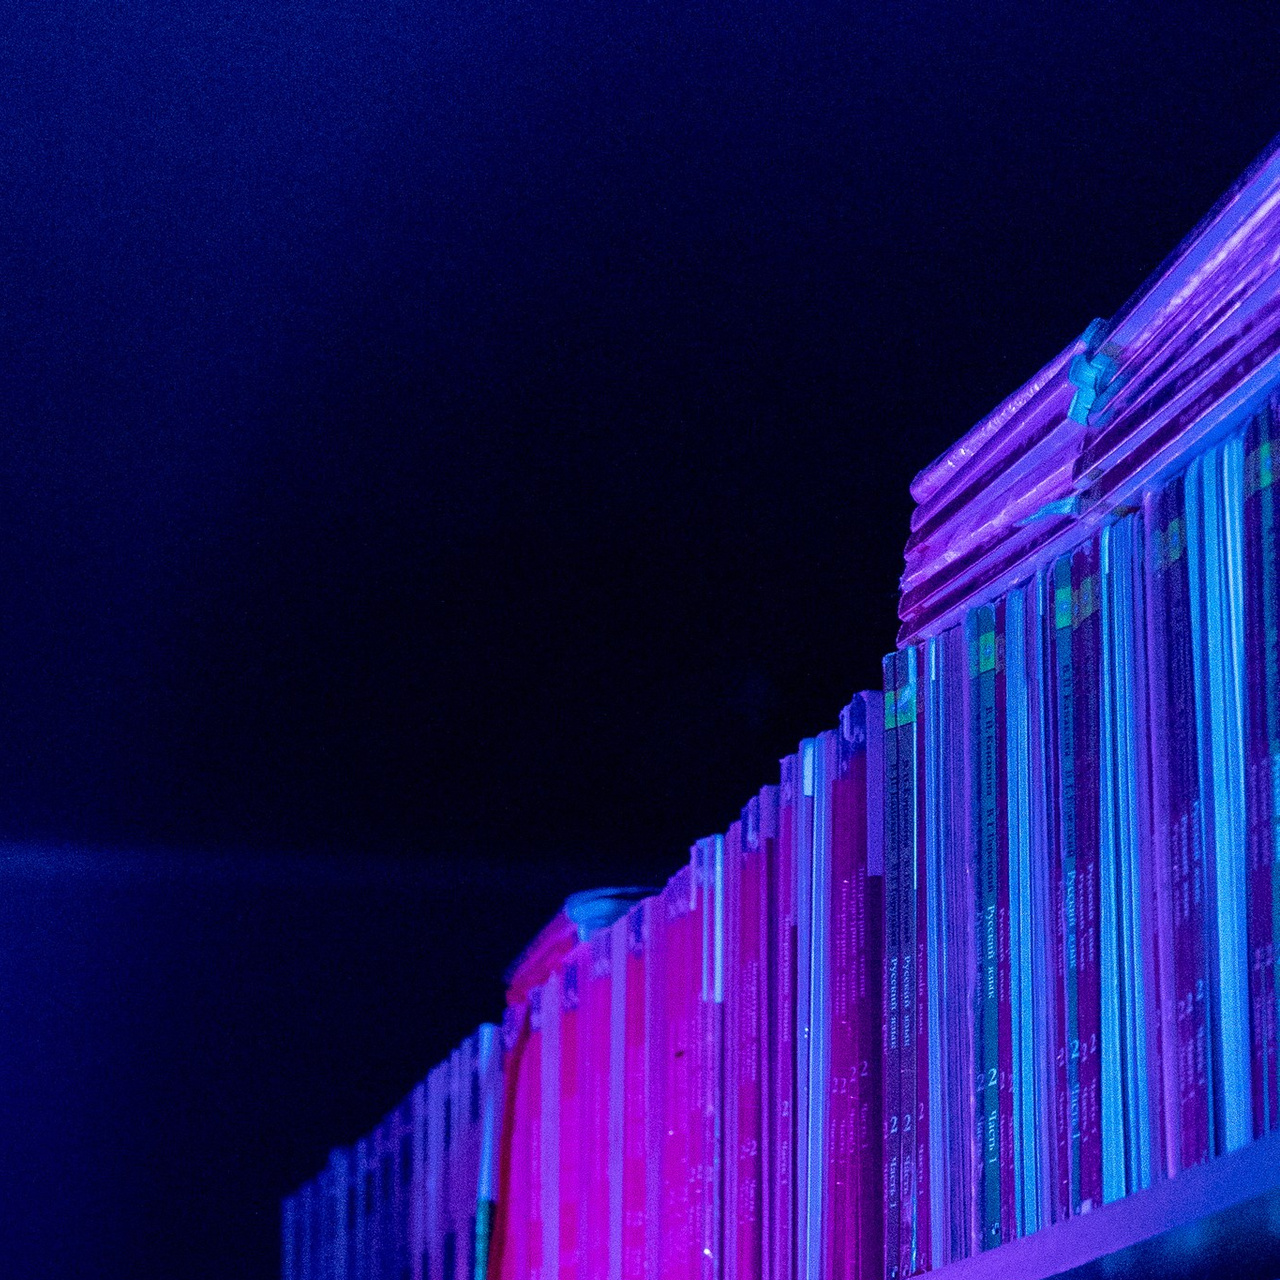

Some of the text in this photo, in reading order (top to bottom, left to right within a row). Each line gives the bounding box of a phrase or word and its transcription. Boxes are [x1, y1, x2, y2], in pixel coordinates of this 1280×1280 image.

[983, 905, 996, 959] Русский
[1065, 870, 1076, 968] Русский язык
[889, 958, 898, 1010] Русский
[902, 956, 911, 1007] Русский
[1070, 1040, 1080, 1059] 2
[988, 1068, 998, 1086] 2
[890, 1116, 898, 1133] 2
[903, 1114, 911, 1132] 2
[1071, 1082, 1080, 1128] Часть
[988, 1110, 998, 1151] Часть
[889, 1157, 897, 1197] Часть
